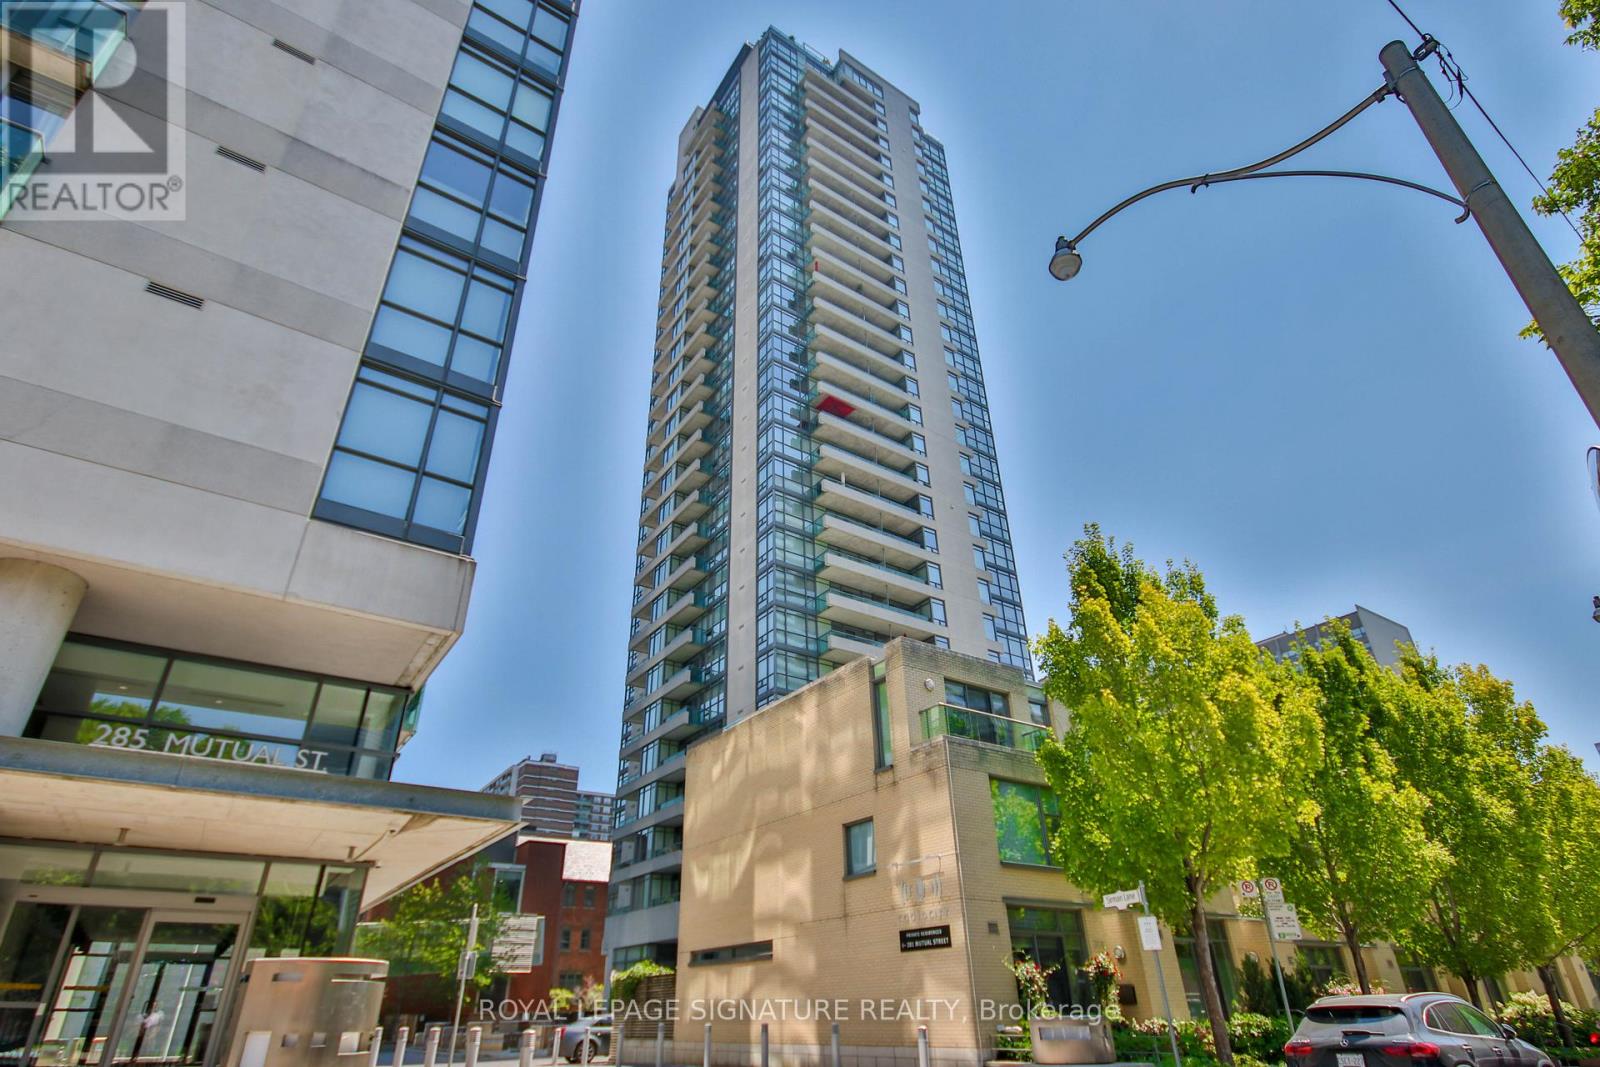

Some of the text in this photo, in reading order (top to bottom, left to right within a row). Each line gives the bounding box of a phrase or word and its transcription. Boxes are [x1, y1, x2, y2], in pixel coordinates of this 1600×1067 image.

[92, 723, 329, 773] 285 MUTUAL ST.
